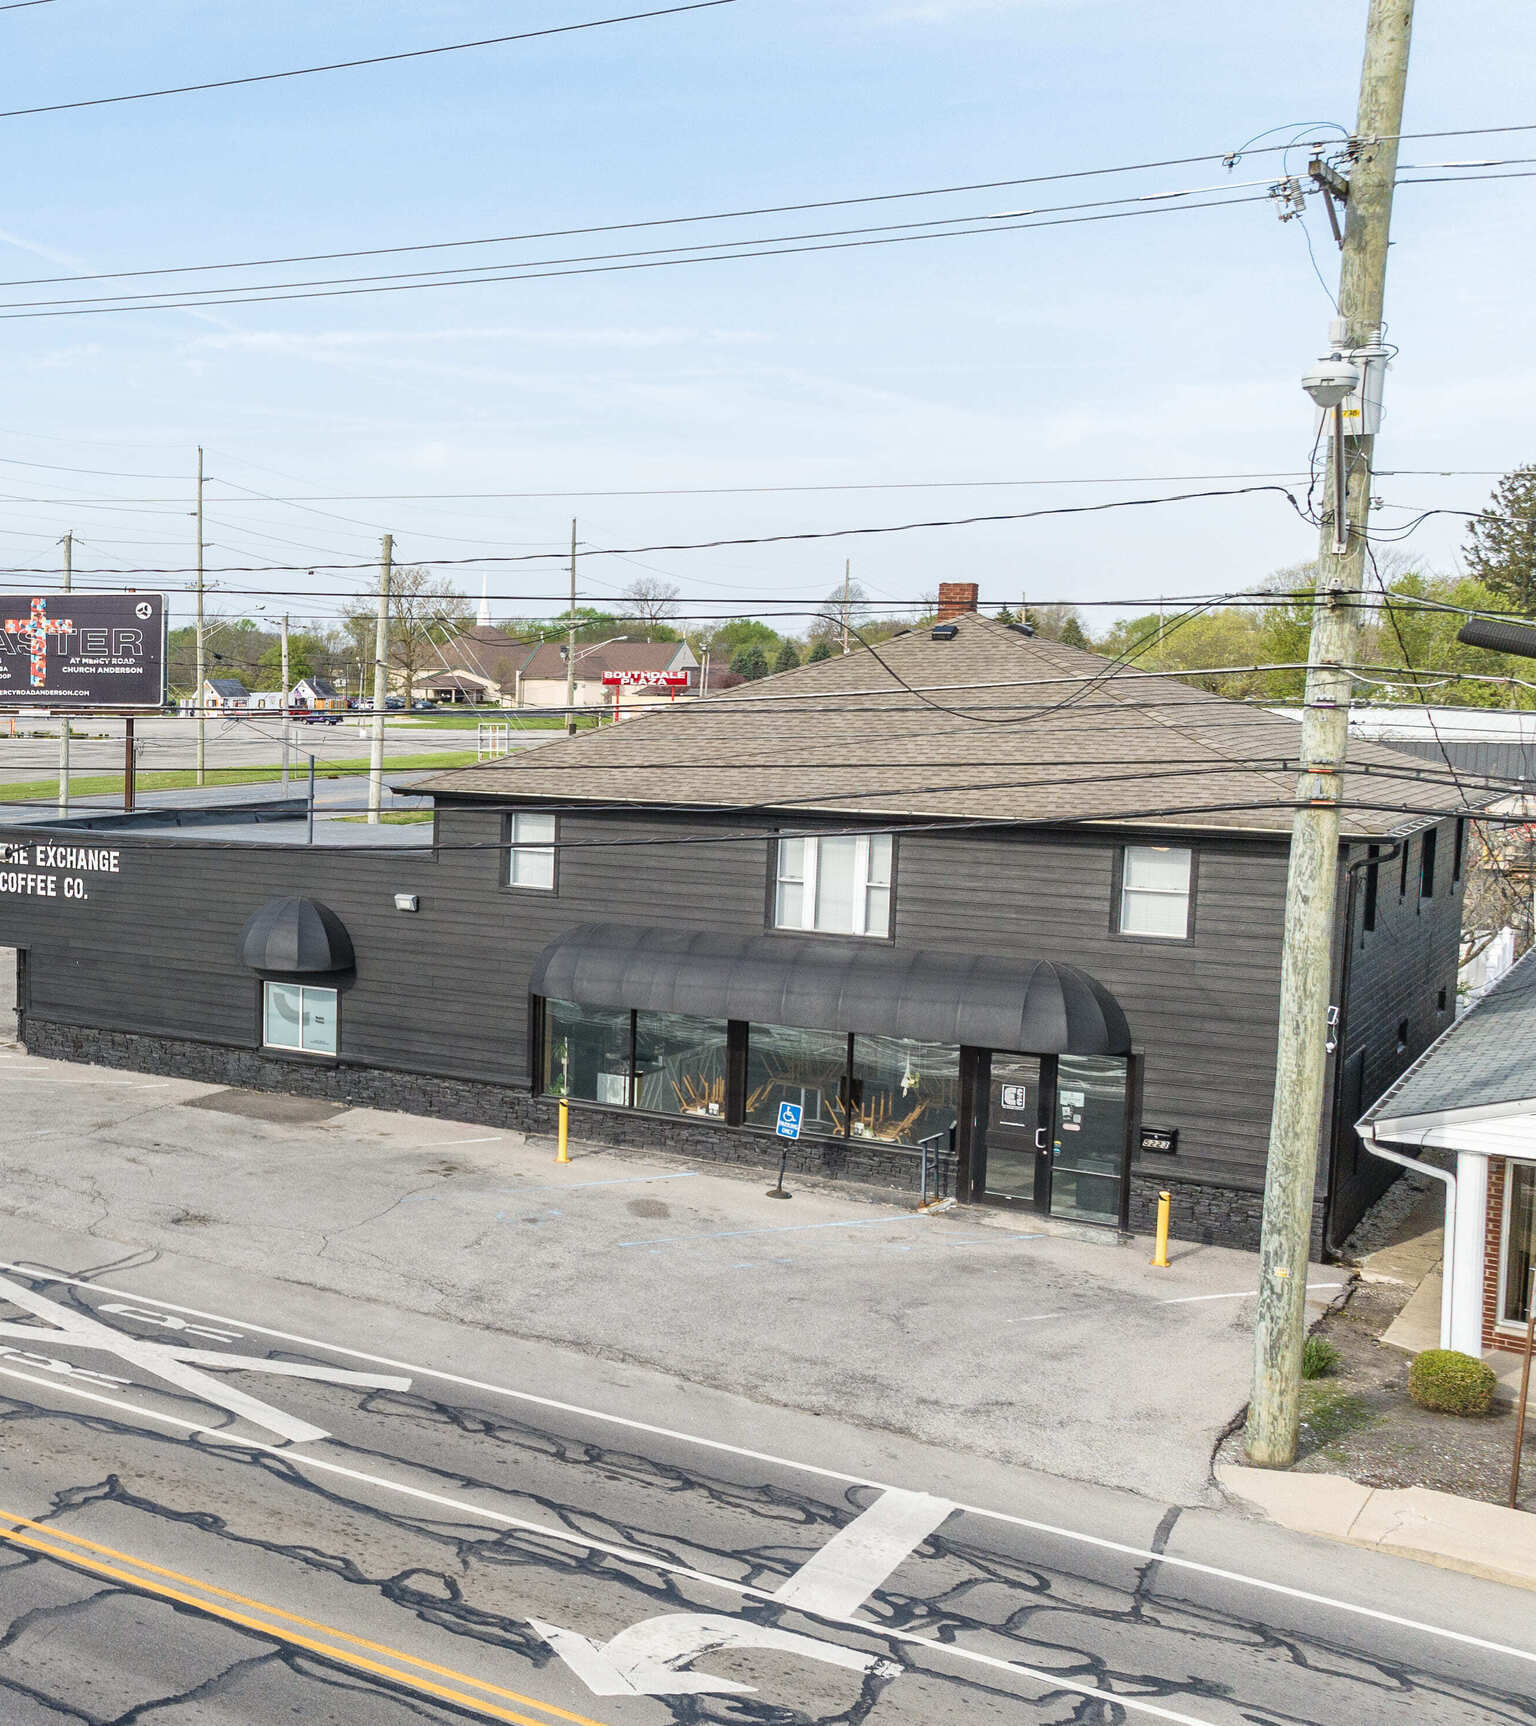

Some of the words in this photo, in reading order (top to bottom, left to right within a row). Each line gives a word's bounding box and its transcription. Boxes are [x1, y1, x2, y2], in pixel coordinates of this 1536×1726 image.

[604, 671, 685, 679] SOUTHDALE
[621, 678, 667, 686] PLAZA
[36, 846, 120, 872] EXCHANGE
[0, 872, 57, 896] COFFEE
[64, 877, 88, 899] CO.
